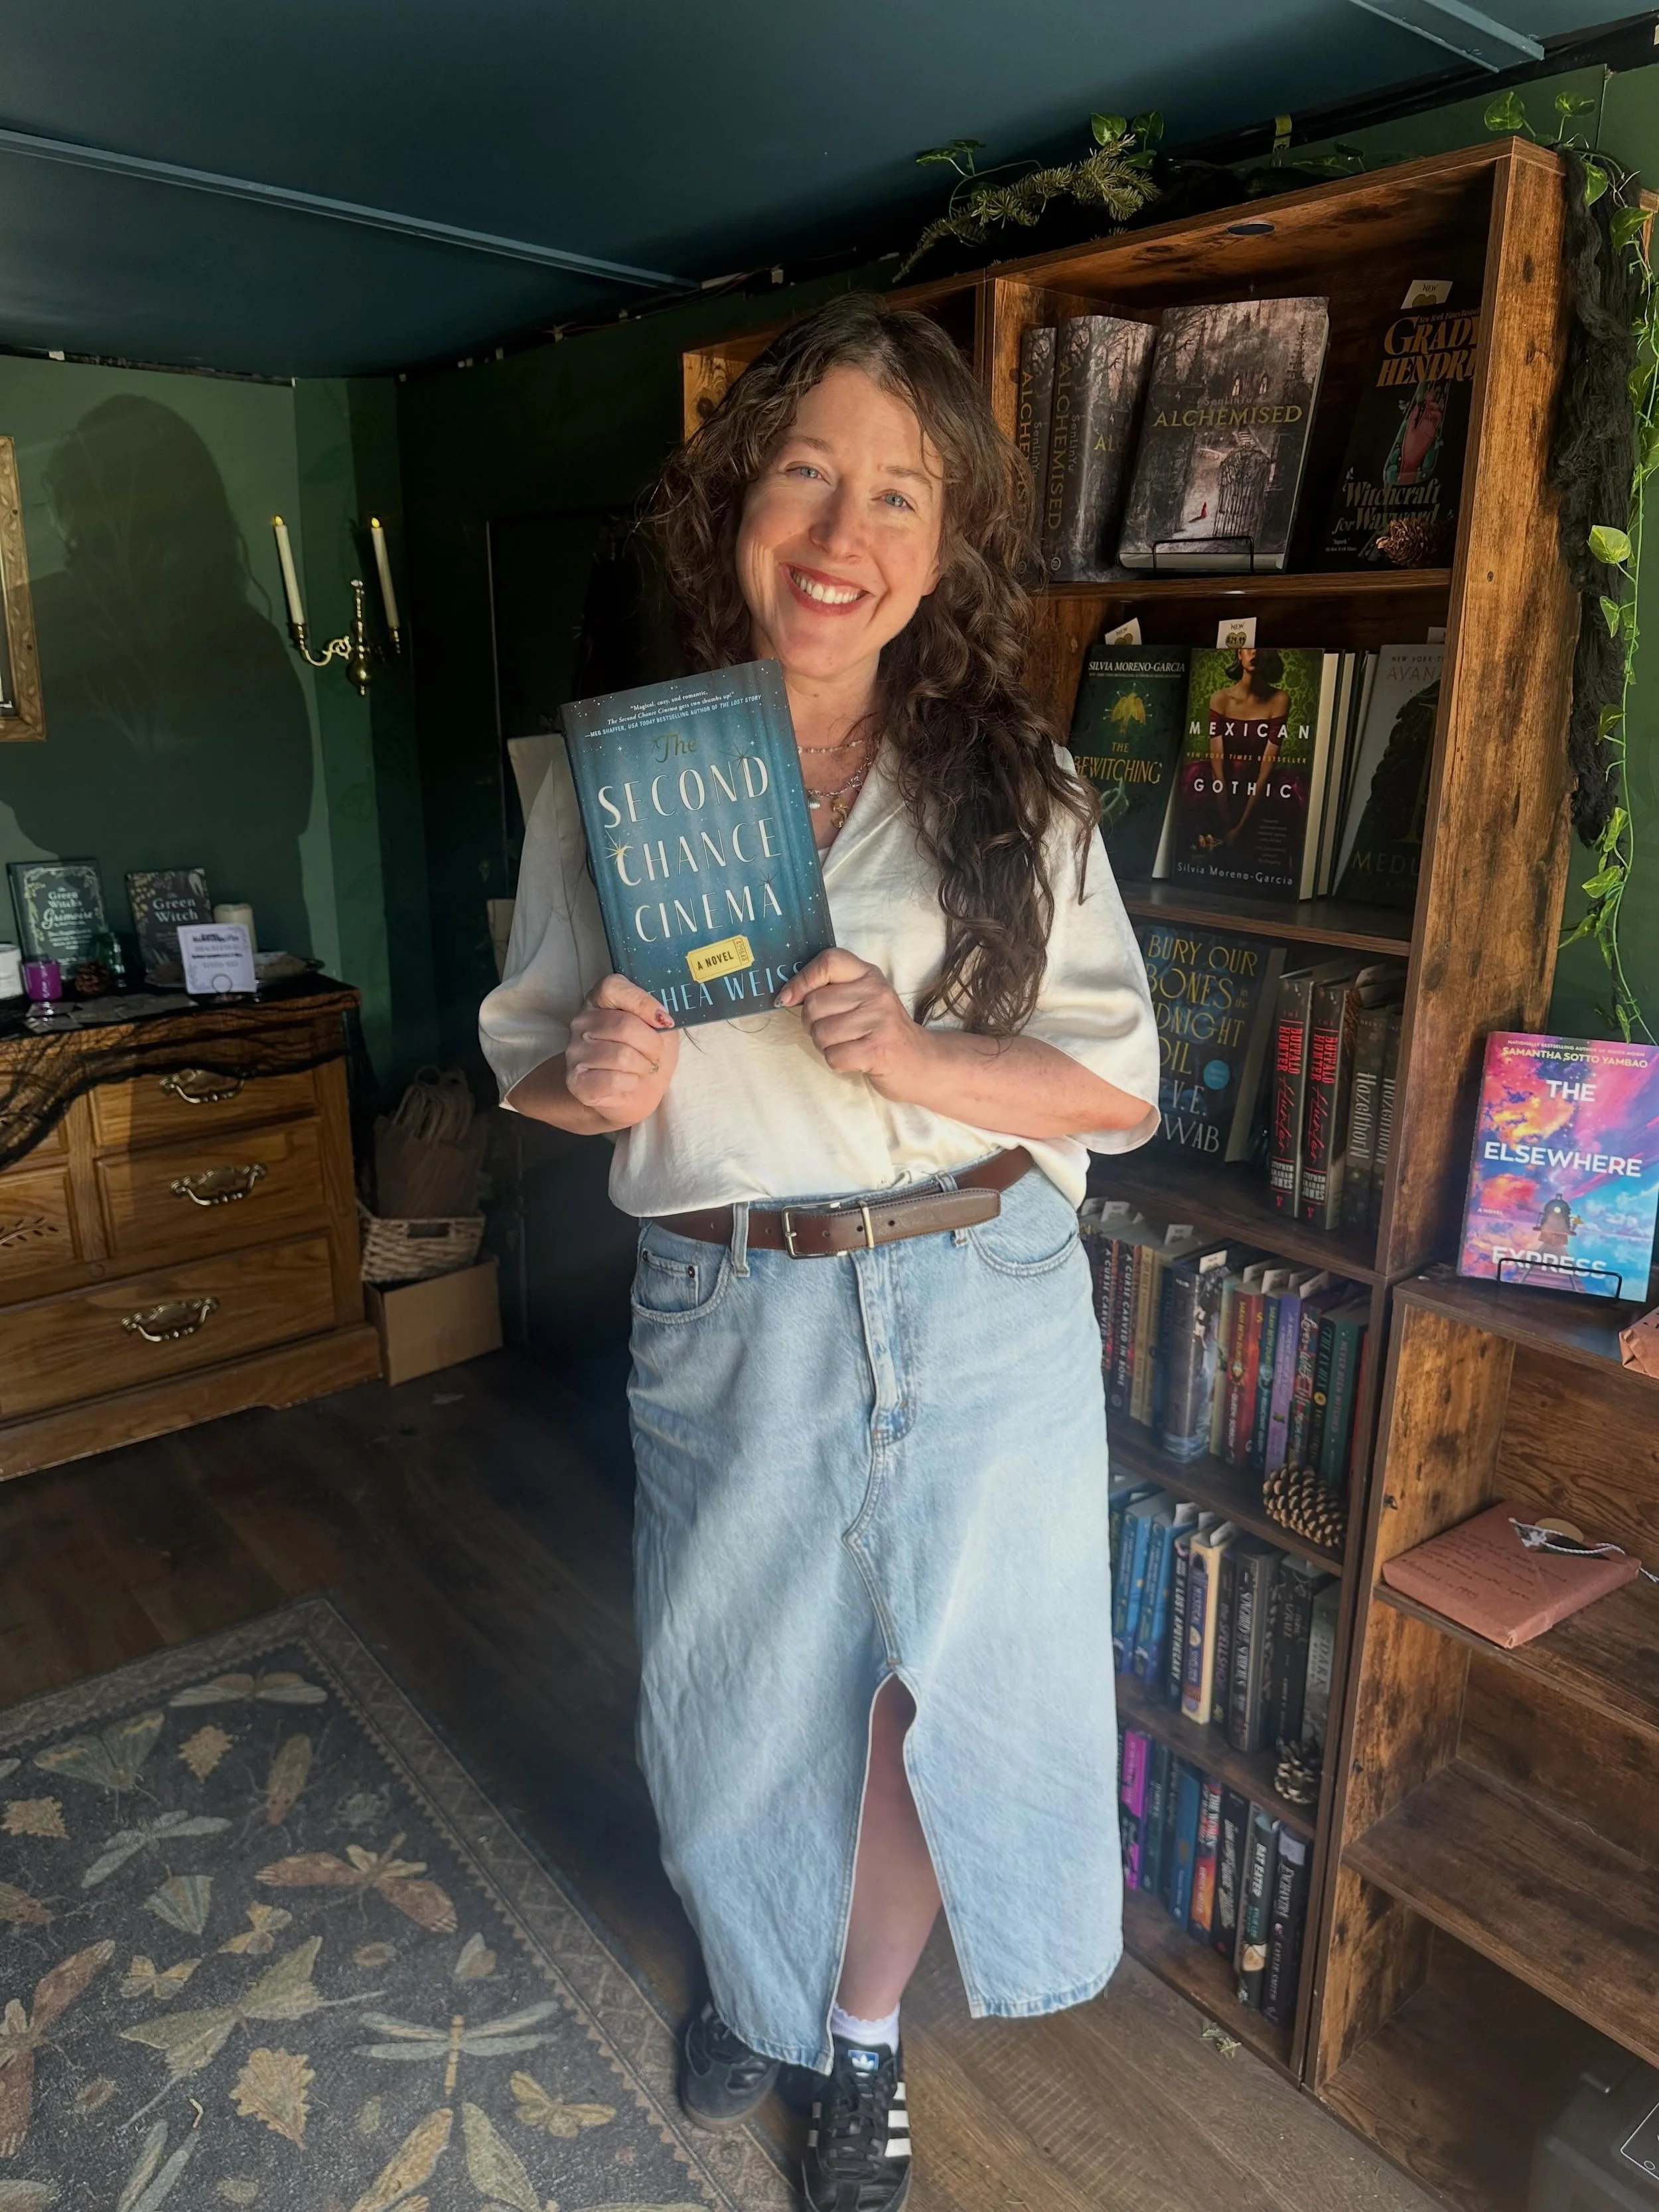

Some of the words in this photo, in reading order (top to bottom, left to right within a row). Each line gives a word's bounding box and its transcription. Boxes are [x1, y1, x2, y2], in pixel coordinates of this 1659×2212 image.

[1376, 348, 1477, 388] HENDRI
[1152, 405, 1303, 427] ALCHEMISED
[1048, 362, 1072, 530] ALCHEMISED
[1342, 478, 1441, 508] Witchcraft
[1331, 517, 1355, 535] for
[1088, 661, 1114, 672] SILVIA
[1114, 662, 1185, 673] MORENO-GARCIA
[1386, 666, 1439, 682] AYAN
[618, 712, 636, 723] Second
[638, 709, 656, 719] Chance
[658, 705, 678, 715] Cinema
[679, 703, 689, 712] gets
[702, 695, 722, 705] thumbs
[682, 690, 708, 700] romantic,
[603, 725, 627, 735] SHAFFER,
[639, 718, 656, 727] TODAY
[656, 711, 689, 723] BESTSELLING
[690, 706, 711, 716] AUTHOR
[731, 698, 744, 707] LOST
[745, 694, 762, 703] STORY
[1189, 721, 1310, 739] MEXICAN
[653, 733, 697, 763] The
[1111, 742, 1130, 753] THE
[1229, 753, 1253, 762] TIMES
[1257, 755, 1307, 765] BESTSELLER
[1073, 755, 1163, 784] BEWITCHING
[597, 755, 770, 828] SECOND
[1193, 778, 1293, 799] GOTHIC
[615, 816, 782, 887] CHANCE
[1352, 850, 1419, 876] MEDU
[1177, 861, 1206, 875] Silvia
[1208, 864, 1294, 886] Moreno-Garcia
[152, 897, 196, 911] Green
[154, 908, 199, 923] Witch
[634, 881, 783, 943] CINEMA
[697, 961, 703, 971] A
[705, 950, 734, 968] NOVEL
[1148, 934, 1202, 965] BURY
[1209, 946, 1258, 976] OUR
[649, 982, 714, 1012] HEA
[1146, 963, 1234, 1009] BONES
[1235, 997, 1249, 1008] the
[1155, 1001, 1245, 1047] DNIGHT
[1276, 1025, 1291, 1072] HUNTER
[1287, 1027, 1303, 1075] BUFFALO
[1310, 1033, 1326, 1082] HUNTER
[1322, 1035, 1338, 1084] BUFFALO
[1501, 1046, 1562, 1060] SAMANTHA
[1563, 1052, 1599, 1063] SOTTO
[1602, 1057, 1648, 1069] YAMBAO
[1541, 1042, 1574, 1051] BESTSELLING
[1546, 1079, 1597, 1102] THE
[1275, 1076, 1295, 1157] Hunter
[1307, 1085, 1329, 1167] Hunter
[1163, 1112, 1220, 1153] WAB
[1483, 1141, 1642, 1178] ELSEWHERE
[1270, 1177, 1294, 1190] JONES
[1302, 1187, 1325, 1201] JONES
[1483, 1207, 1504, 1217] NOVEL
[1103, 1259, 1112, 1291] CURSE
[1492, 1245, 1607, 1280] EXPRESS
[1123, 1265, 1133, 1297] CURSE
[1120, 1301, 1131, 1342] CARVED
[1119, 1345, 1127, 1356] IN
[1337, 1340, 1348, 1370] NEVER
[1335, 1370, 1345, 1394] BEEN
[1174, 1586, 1186, 1615] LOST
[1171, 1614, 1184, 1682] APOTHECARY
[1254, 1842, 1267, 1865] BAT
[1252, 1865, 1266, 1899] EATER
